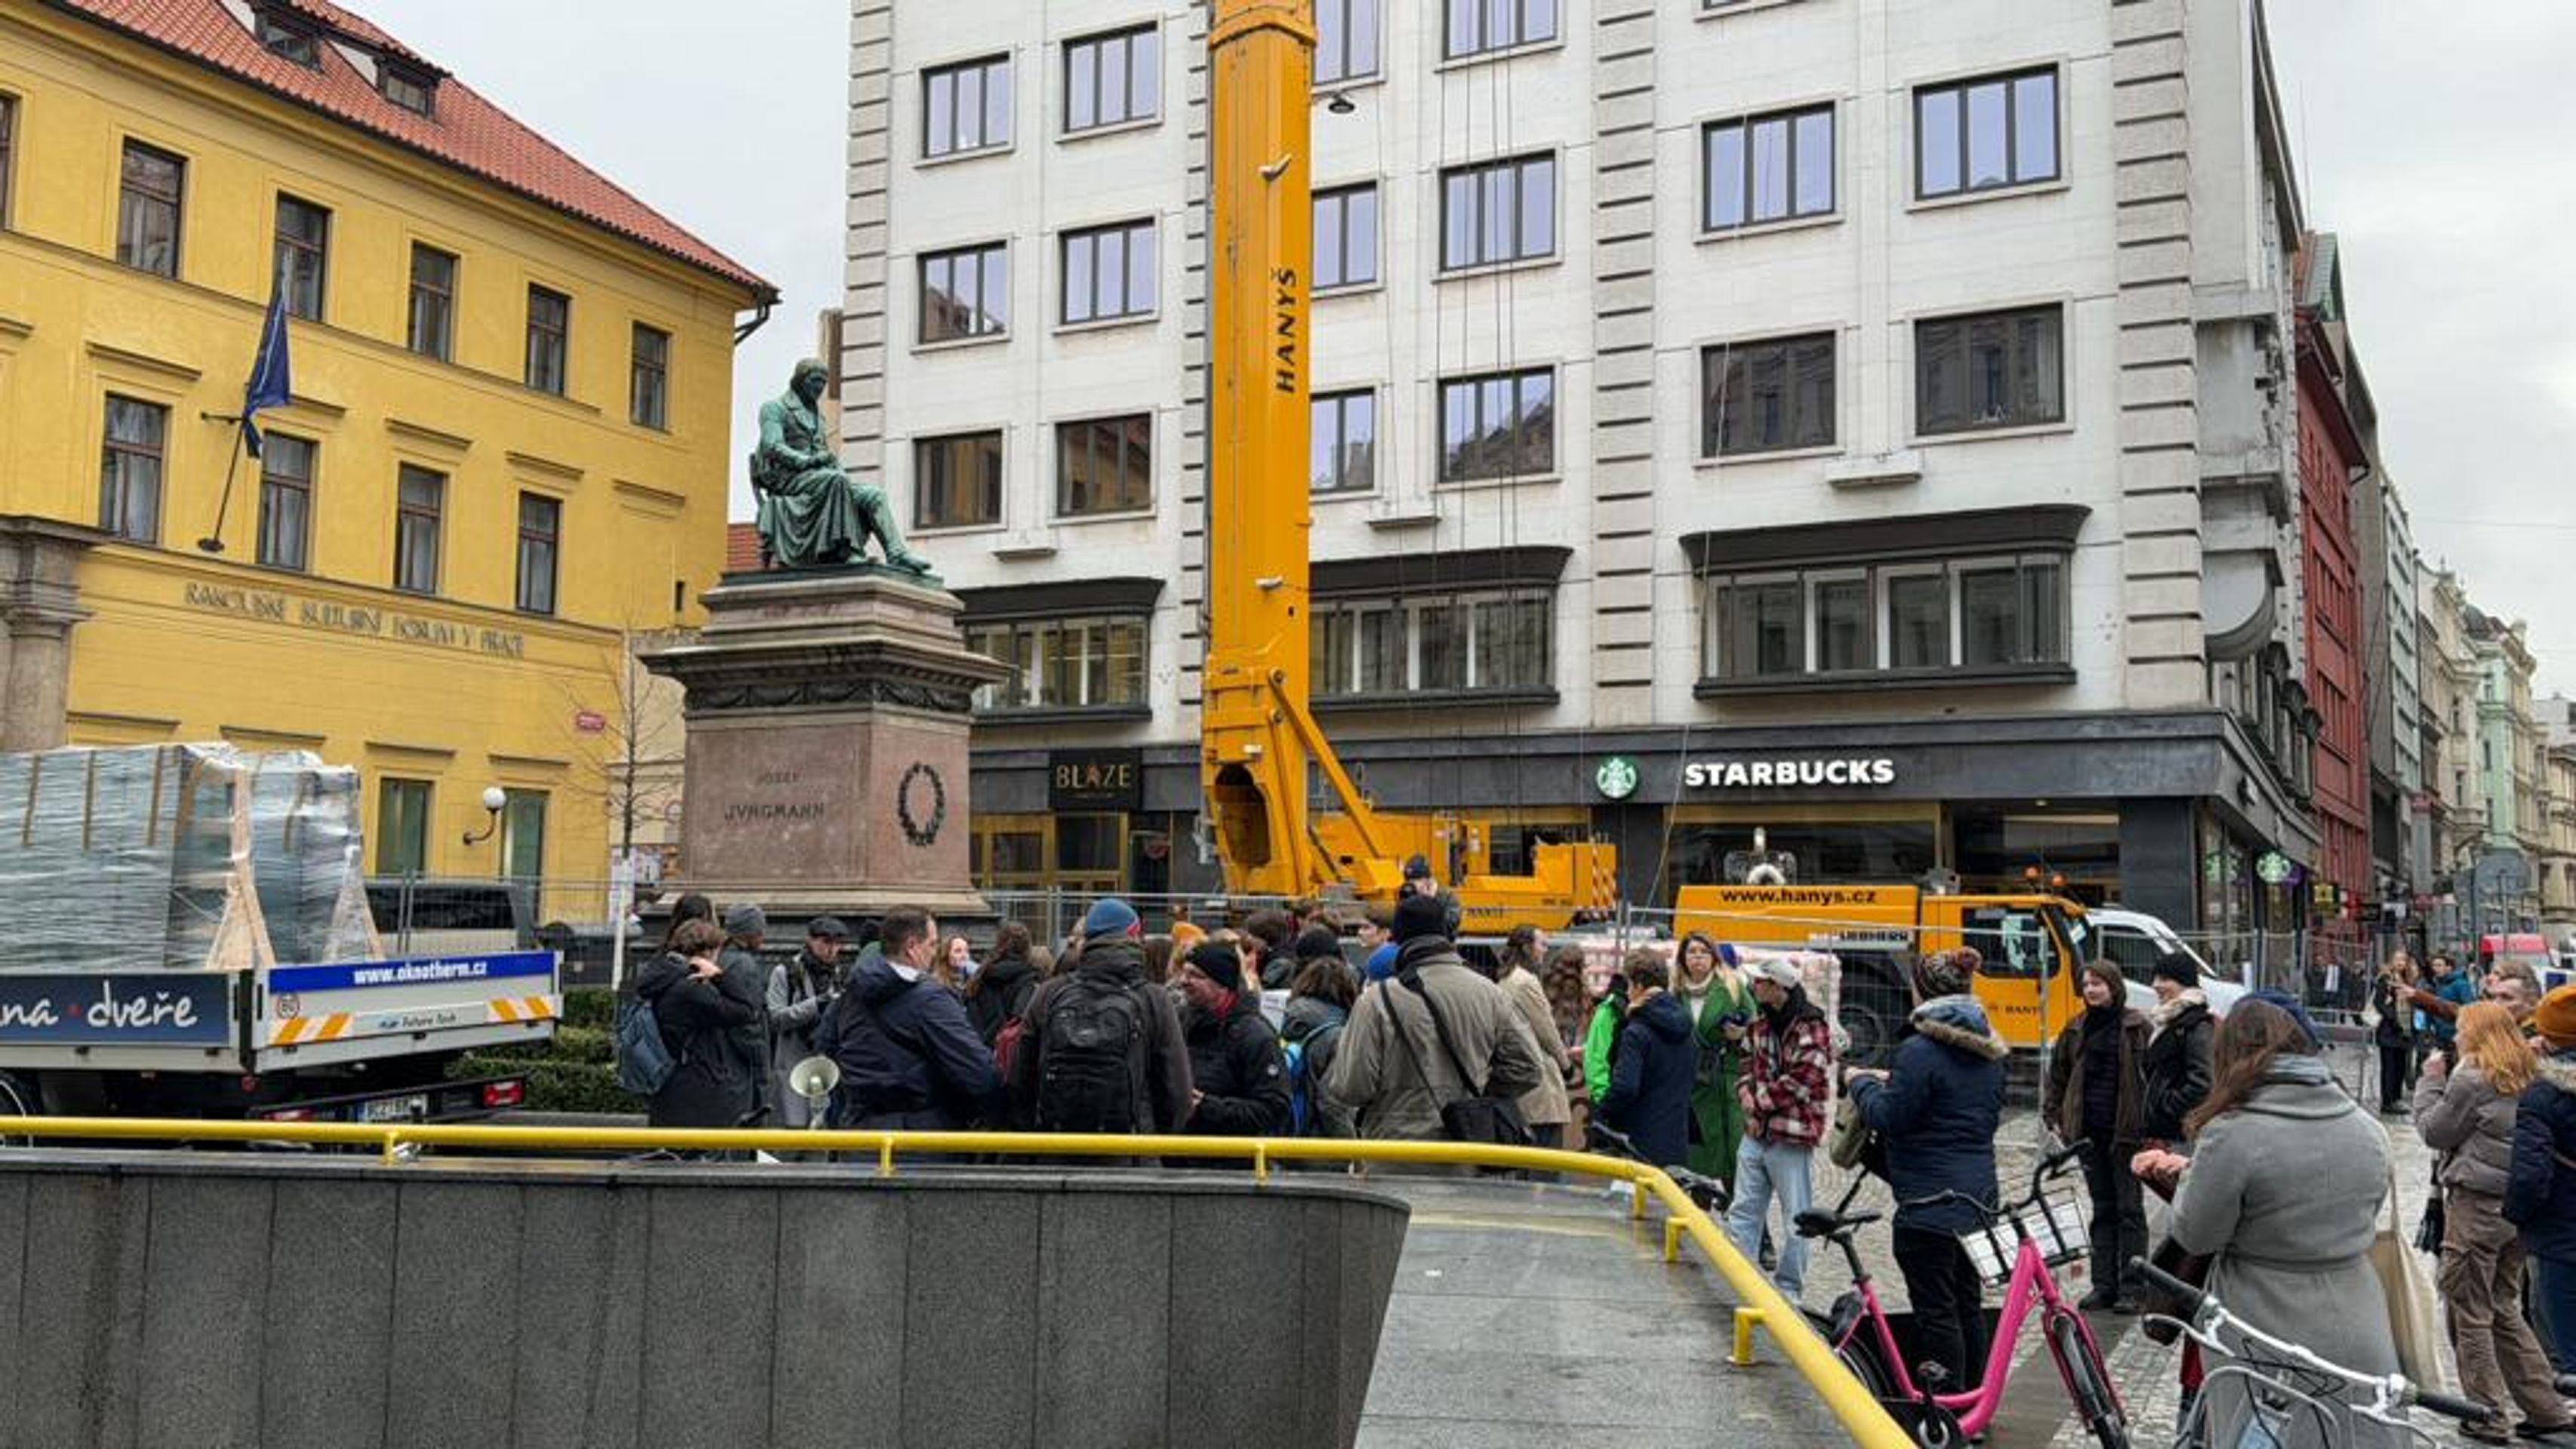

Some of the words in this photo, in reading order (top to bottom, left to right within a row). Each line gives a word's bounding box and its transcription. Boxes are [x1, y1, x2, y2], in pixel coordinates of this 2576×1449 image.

[1271, 268, 1297, 393] HANYŠ
[1057, 764, 1131, 790] BLAZE
[1685, 758, 1895, 786] STARBUCKS
[1722, 888, 1876, 906] www.hanys.cz
[88, 980, 197, 1027] dveře
